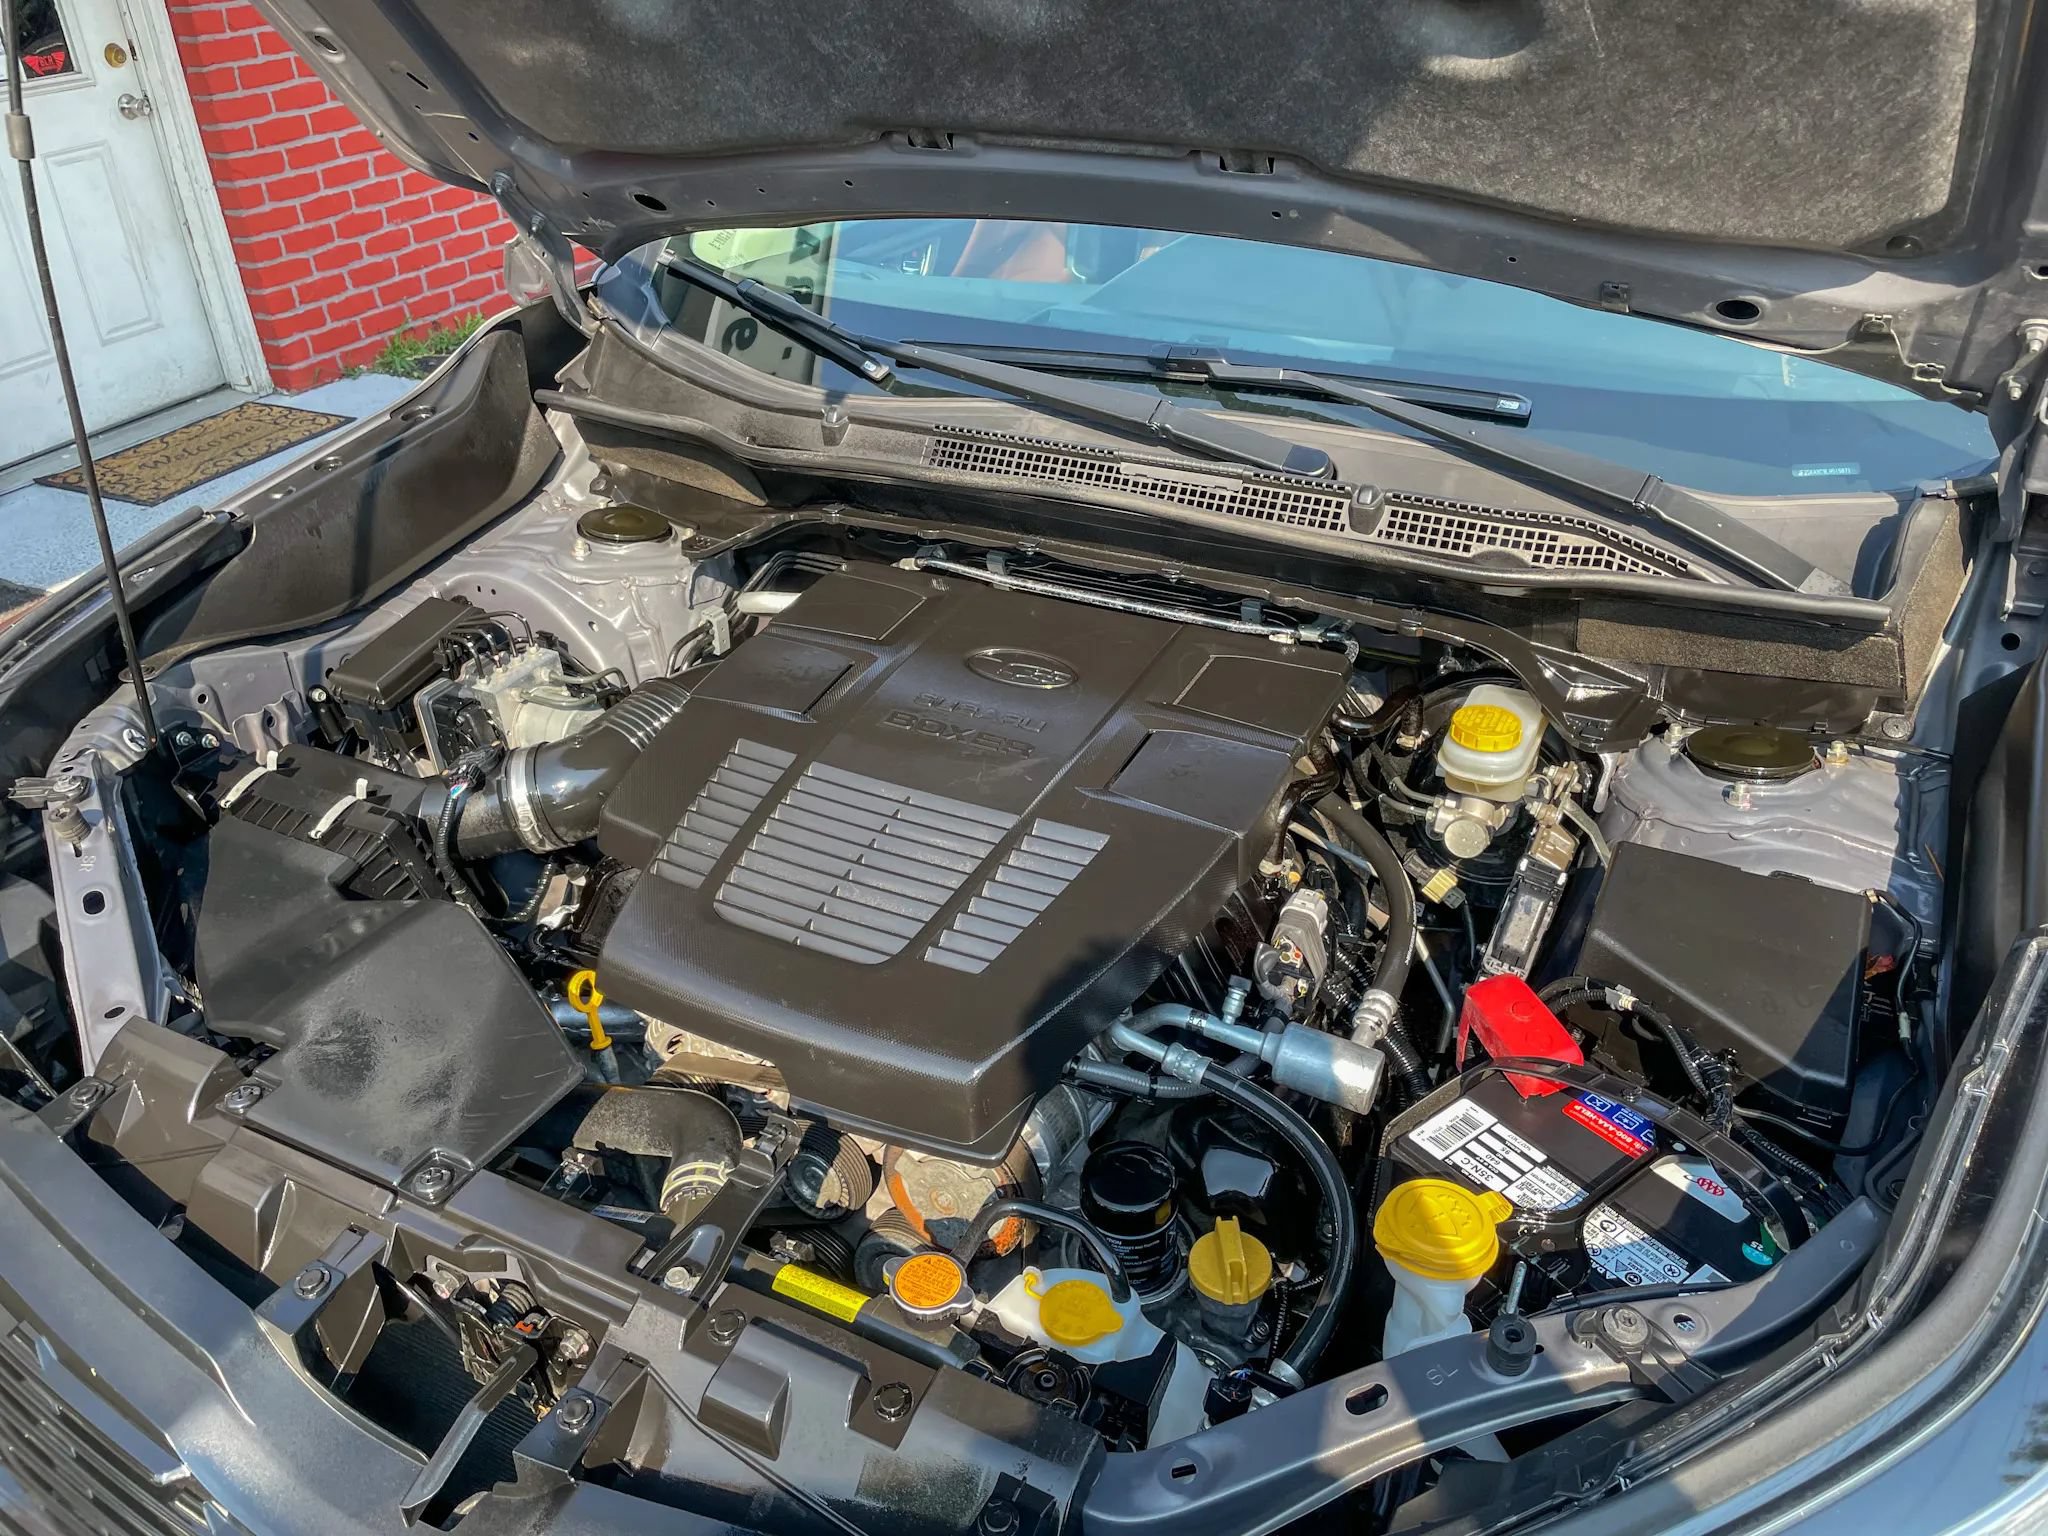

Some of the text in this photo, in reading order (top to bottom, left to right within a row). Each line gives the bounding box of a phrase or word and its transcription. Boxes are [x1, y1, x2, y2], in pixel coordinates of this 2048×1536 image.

[138, 424, 257, 470] Welcome
[914, 692, 1047, 733] SUBARU
[883, 709, 1036, 759] BOXER
[1573, 1102, 1633, 1143] 800-AAA-HELP
[1484, 1153, 1501, 1165] 640
[1499, 1146, 1511, 1154] 95
[1458, 1156, 1494, 1181] 35N-C
[1467, 1174, 1482, 1184] PART
[1698, 1178, 1724, 1195] AAA
[1749, 1240, 1764, 1252] 25
[1426, 1364, 1459, 1387] SL
